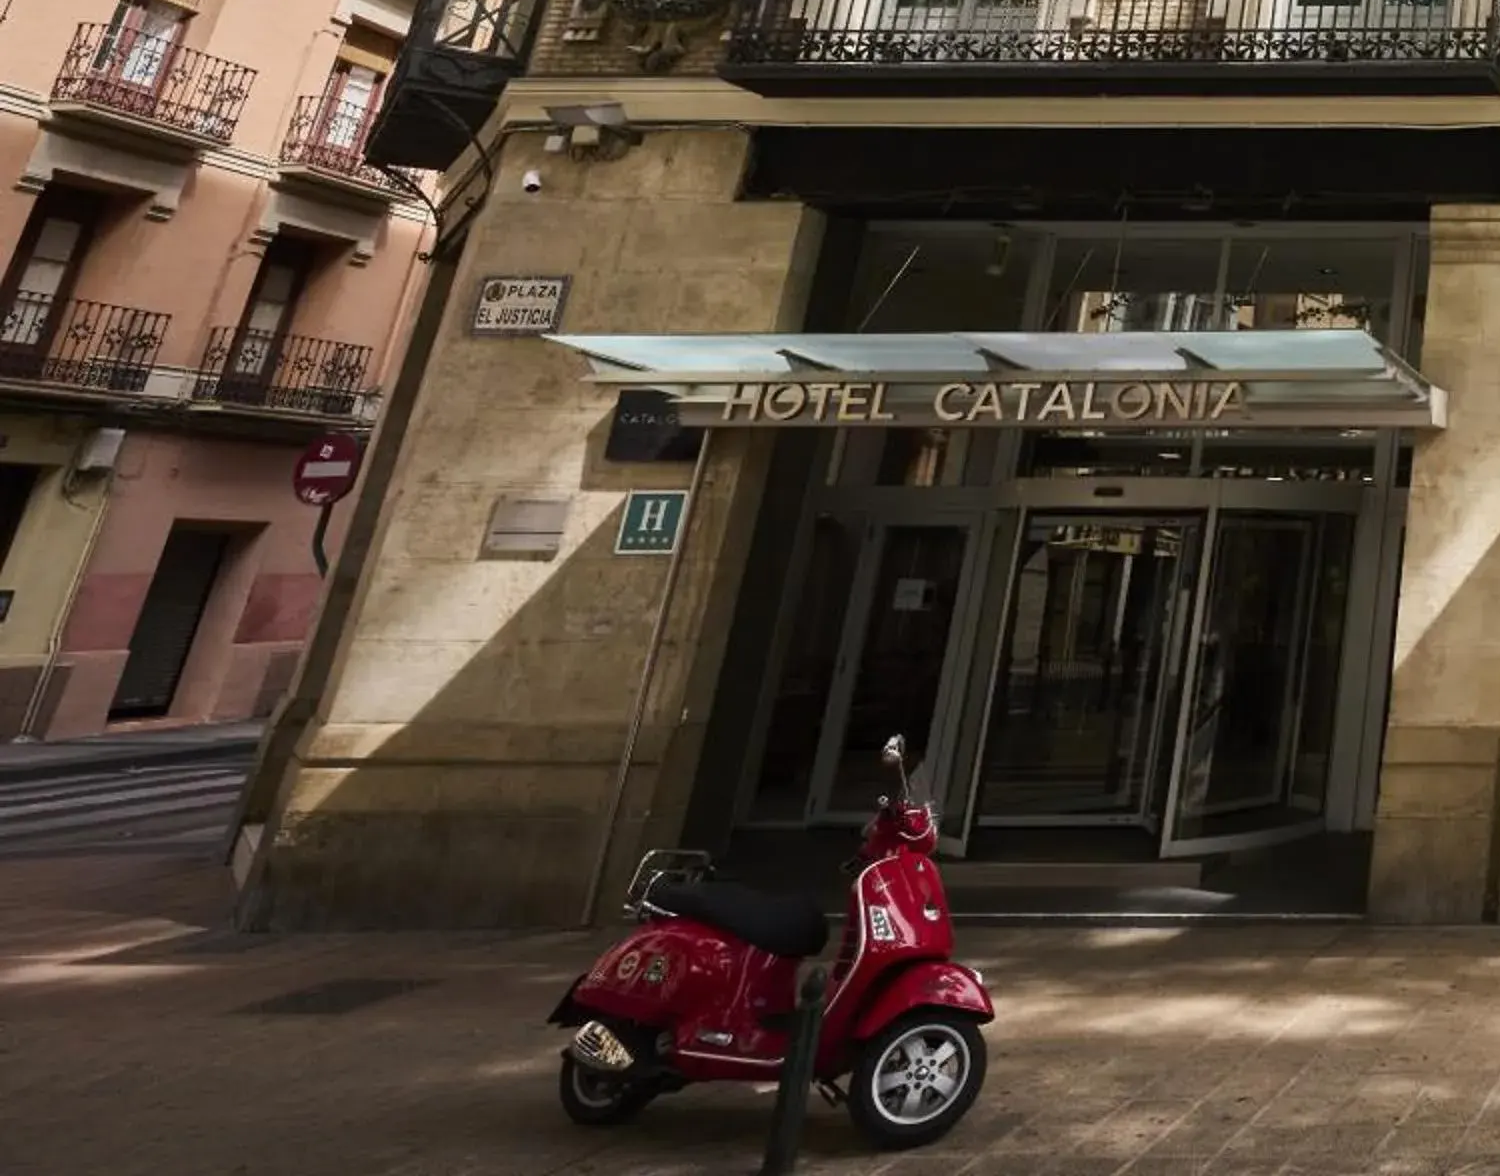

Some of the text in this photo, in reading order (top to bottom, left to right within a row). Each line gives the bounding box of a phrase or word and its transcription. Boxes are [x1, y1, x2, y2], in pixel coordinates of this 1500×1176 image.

[507, 285, 557, 297] PLAZA
[478, 308, 552, 324] EL JUSTICIA
[722, 381, 1248, 421] HOTEL CATALONIA
[638, 499, 670, 531] H
